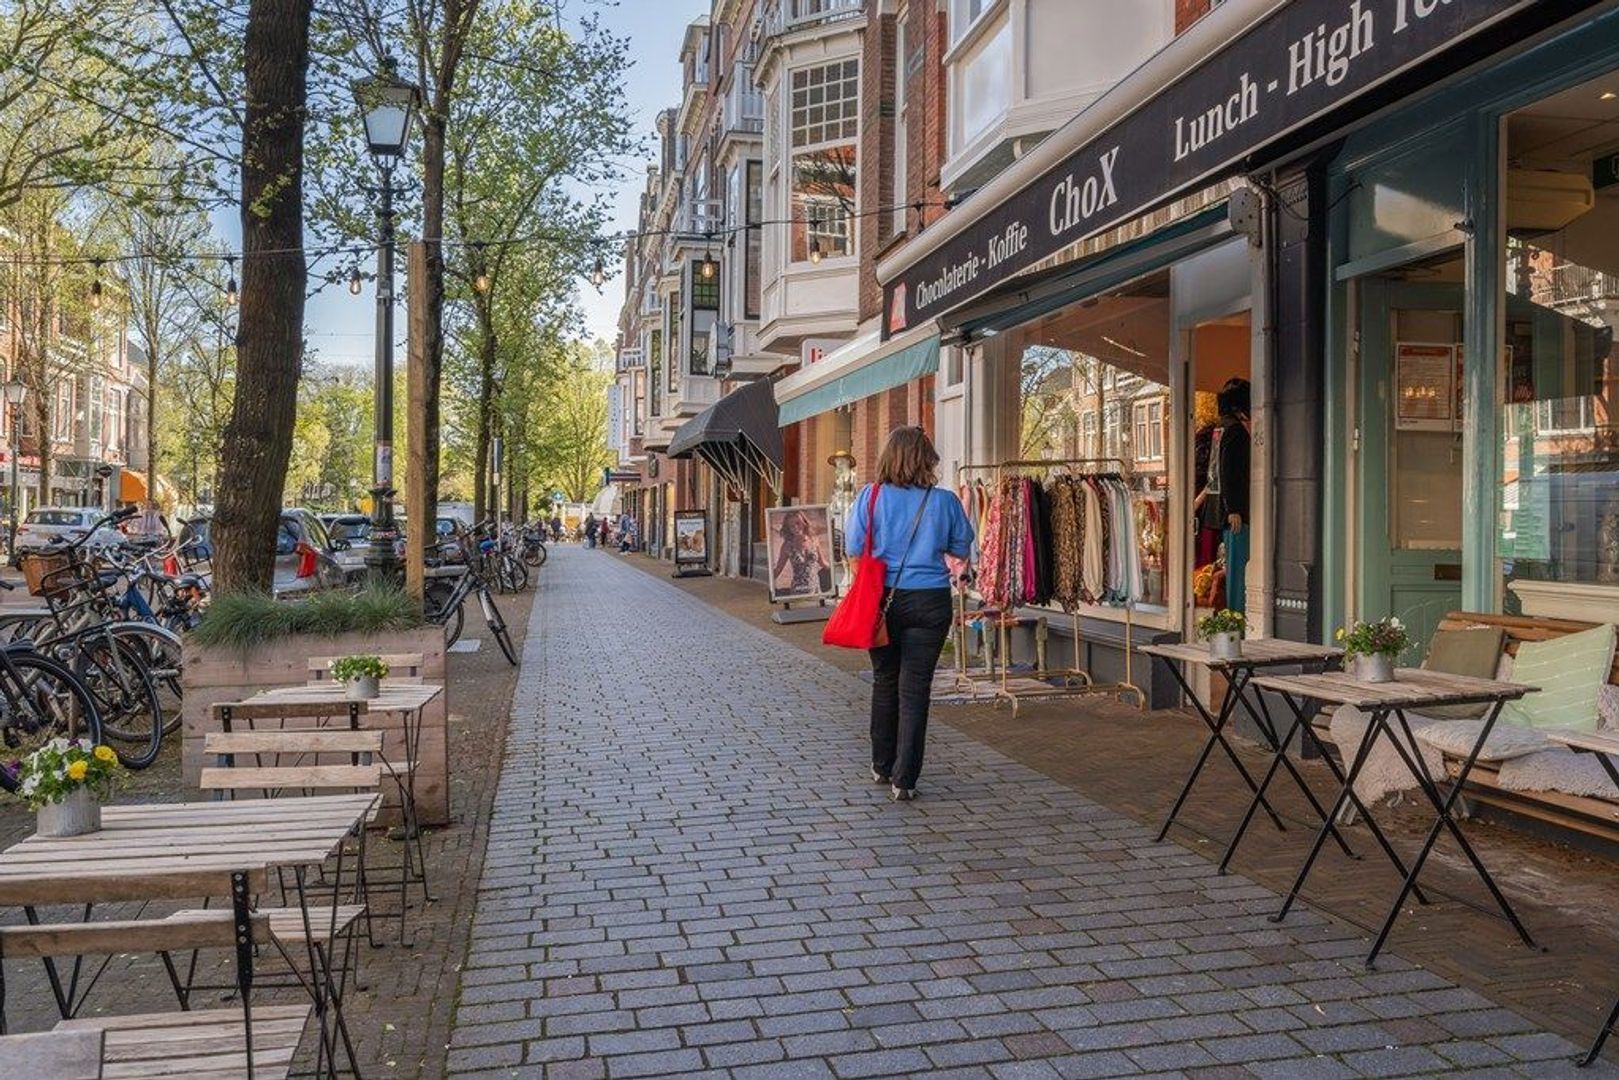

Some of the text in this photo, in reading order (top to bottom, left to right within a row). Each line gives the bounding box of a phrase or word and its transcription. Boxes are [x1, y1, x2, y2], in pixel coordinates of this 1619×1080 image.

[1174, 73, 1258, 162] Lunch
[1286, 2, 1375, 96] High
[1049, 145, 1120, 236] ChoX
[915, 251, 979, 310] Chocolaterie
[988, 221, 1028, 270] Koffie
